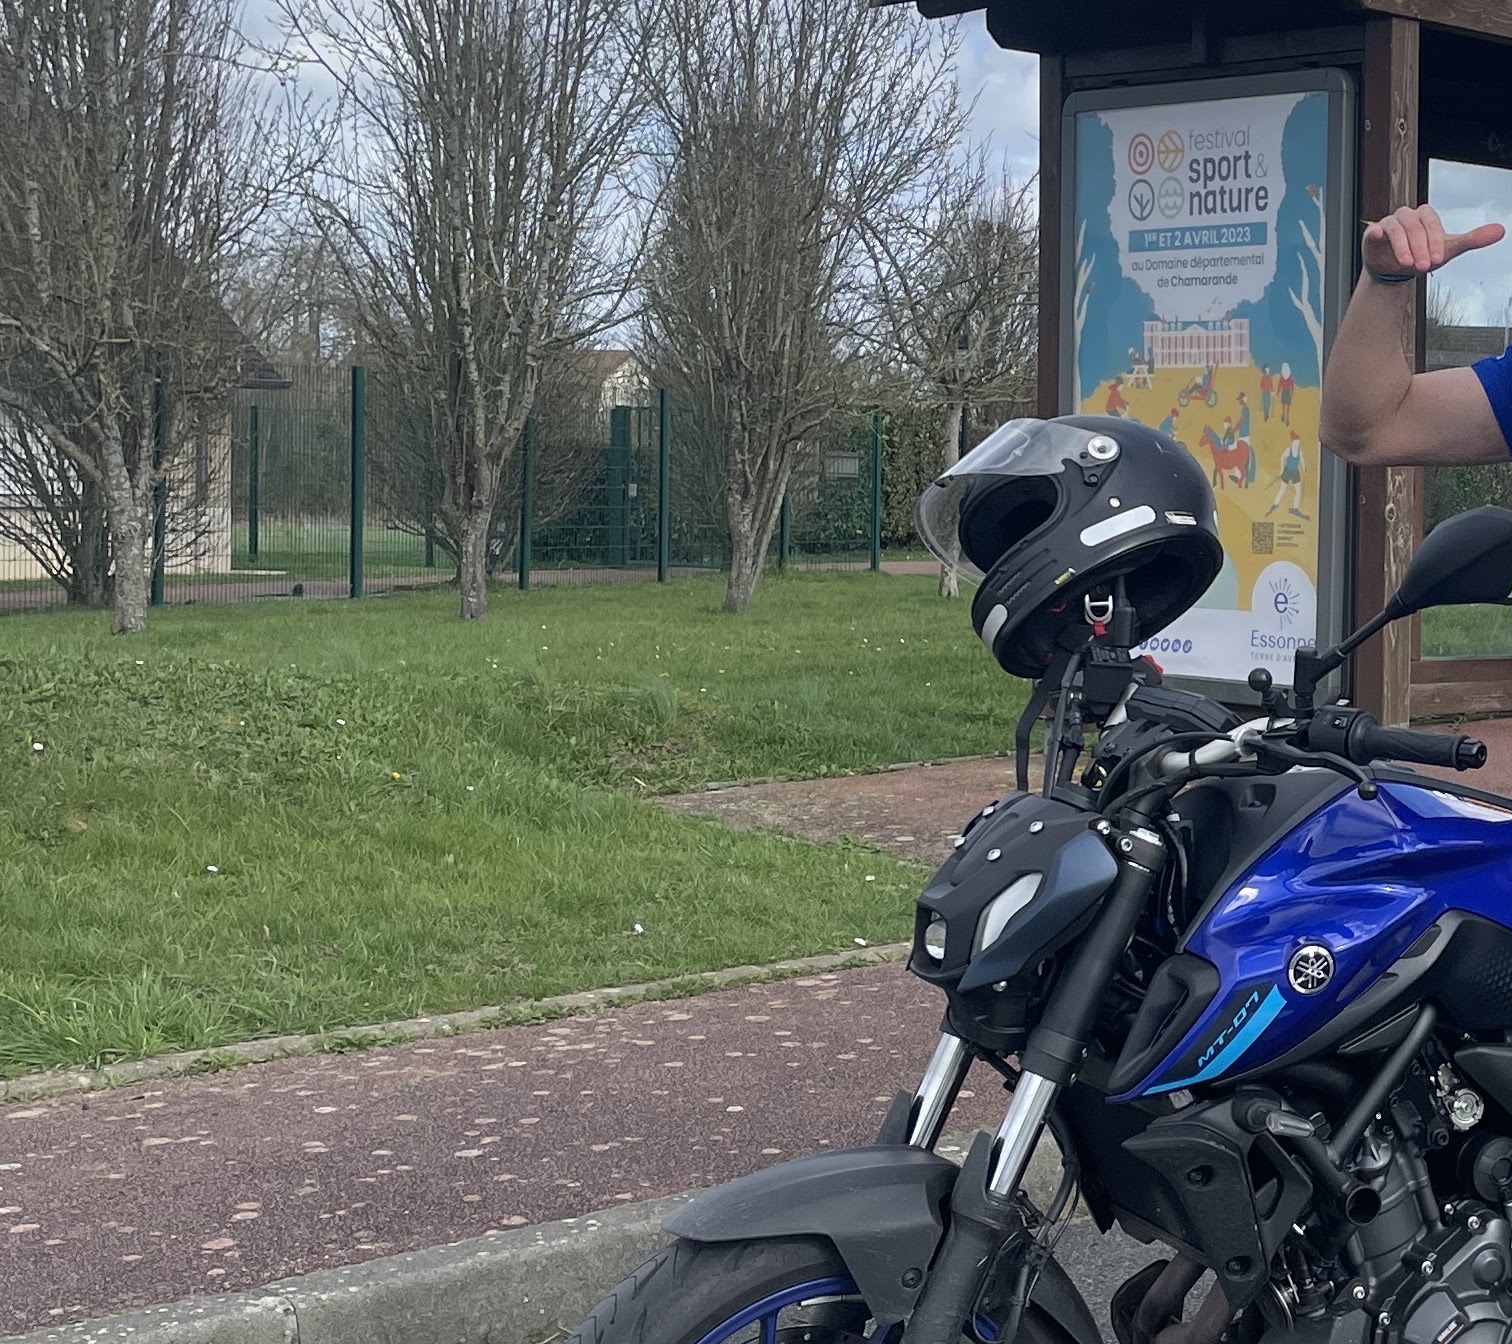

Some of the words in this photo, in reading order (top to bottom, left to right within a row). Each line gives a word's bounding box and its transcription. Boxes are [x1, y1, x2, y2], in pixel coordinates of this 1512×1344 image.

[1188, 125, 1251, 151] festival
[1188, 150, 1252, 190] sport
[1254, 152, 1269, 179] &
[1189, 185, 1269, 216] nature
[1159, 232, 1173, 247] ET
[1174, 231, 1182, 246] 2
[1183, 229, 1219, 246] AVRIL
[1220, 226, 1251, 243] 2023
[1131, 261, 1144, 271] au
[1145, 258, 1189, 271] Domaine
[1190, 252, 1265, 272] départemental
[1157, 277, 1169, 288] de
[1170, 272, 1239, 287] Chamarande
[1275, 653, 1295, 663] D'AV
[1198, 990, 1259, 1068] MT-07
